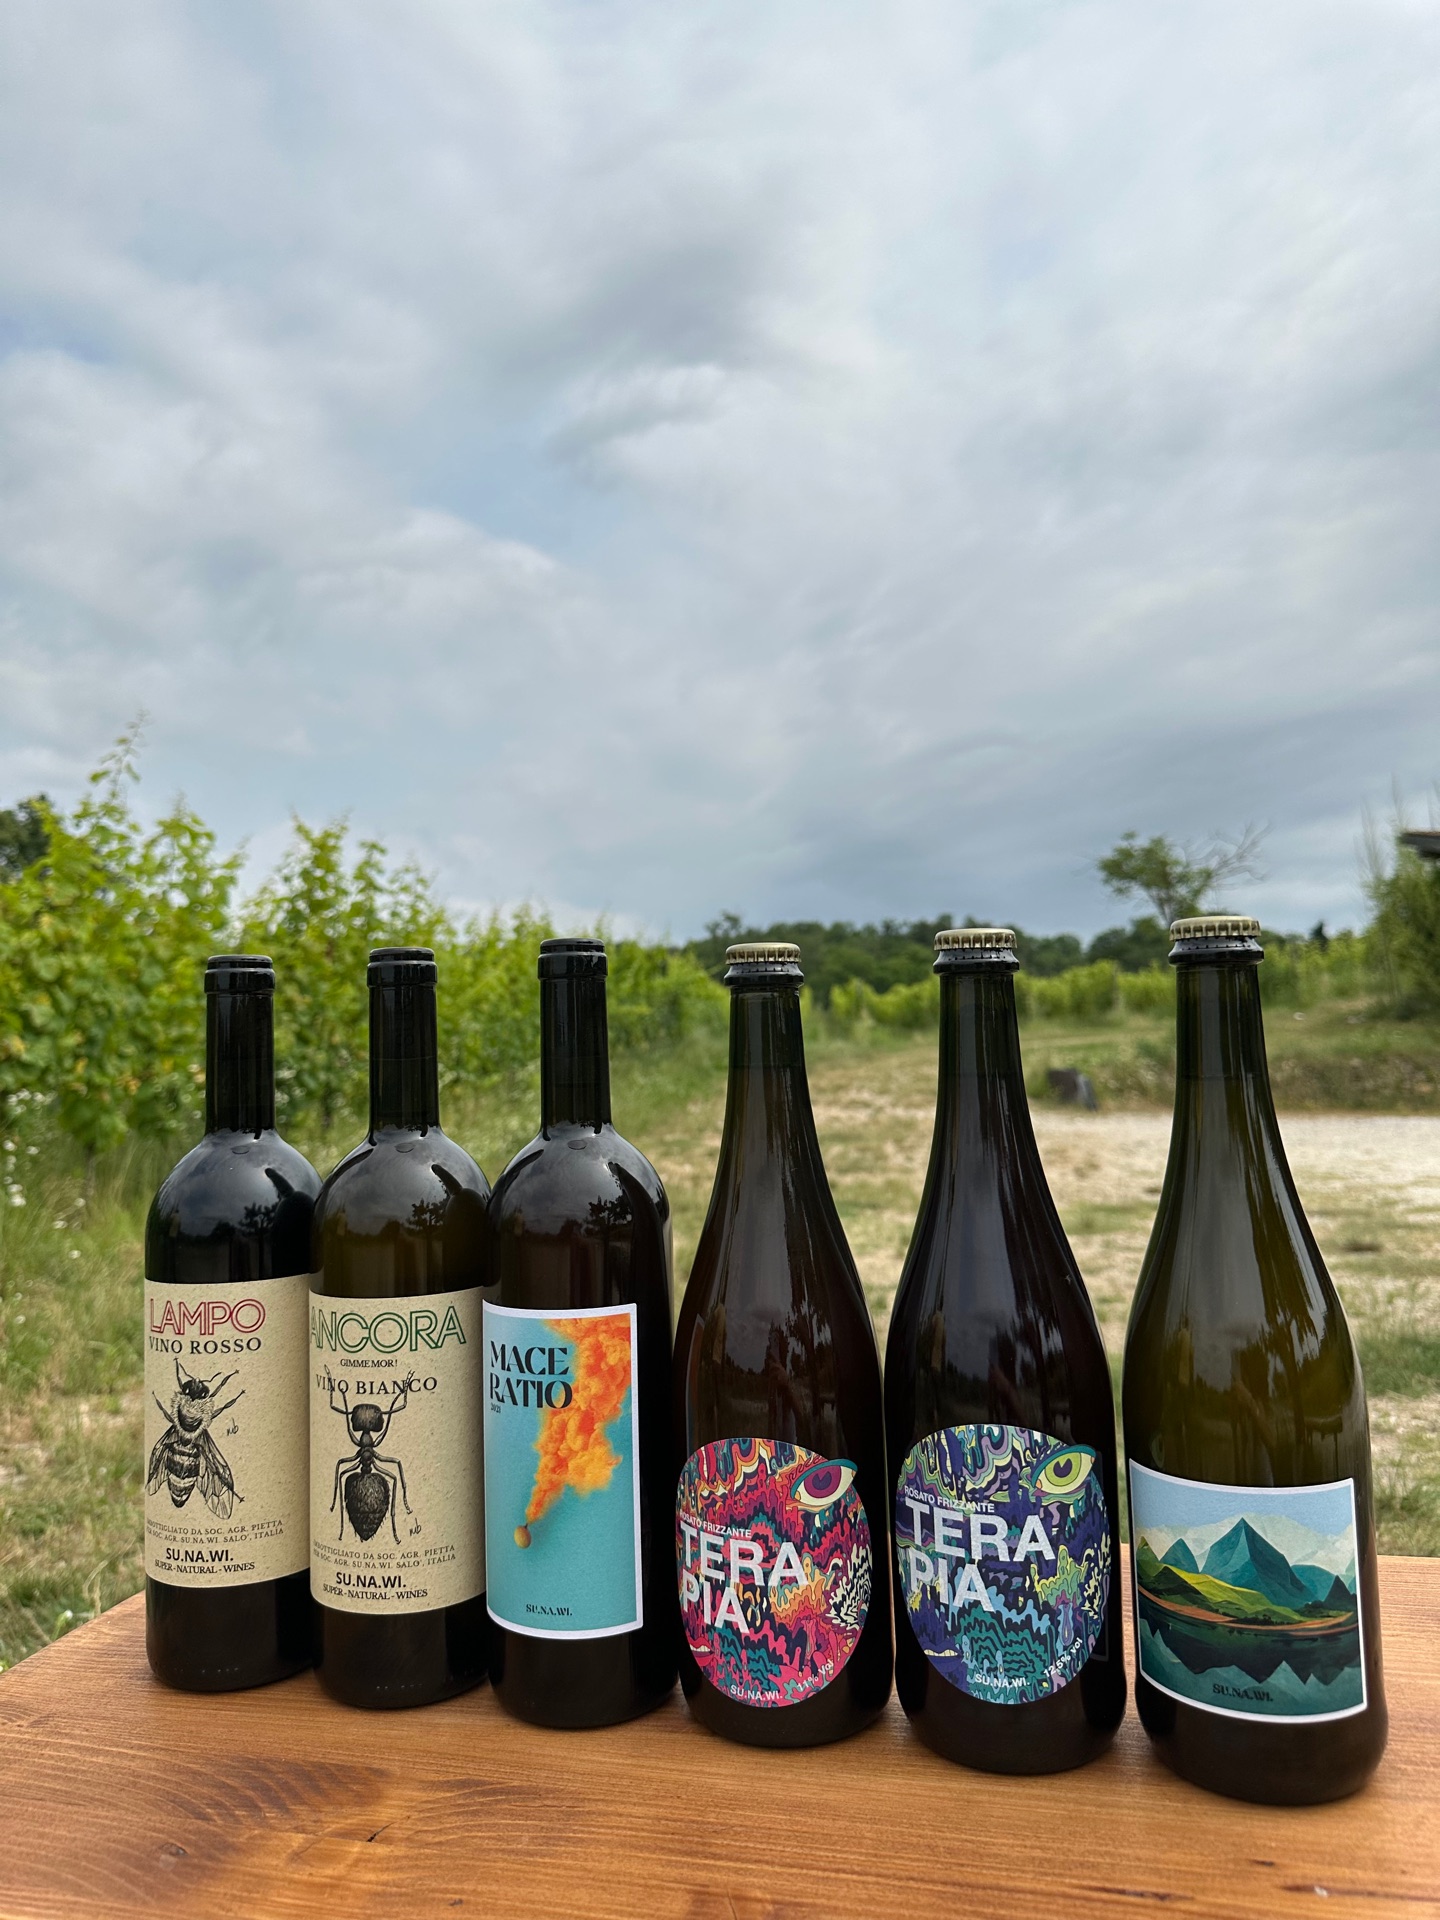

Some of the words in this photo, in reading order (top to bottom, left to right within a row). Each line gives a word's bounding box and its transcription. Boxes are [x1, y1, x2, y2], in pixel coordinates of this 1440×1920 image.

[150, 1298, 266, 1335] LAMPO
[310, 1306, 467, 1353] ANCORA
[149, 1335, 183, 1354] VINO
[190, 1337, 262, 1354] ROSSO
[340, 1358, 370, 1367] GIMME
[490, 1340, 569, 1375] MACE
[316, 1374, 349, 1393] VINO
[356, 1377, 437, 1395] BIANCO
[490, 1372, 573, 1409] RATIO
[904, 1485, 935, 1504] ROSATO
[937, 1496, 995, 1513] FRIZZANTE
[228, 1525, 249, 1533] AGR.
[251, 1519, 283, 1531] PIETTA
[255, 1528, 284, 1540] ITALIA
[703, 1520, 752, 1538] FRIZZANTE
[905, 1496, 1056, 1562] TERA
[166, 1547, 234, 1563] SU.NA.WI.
[363, 1552, 374, 1560] DA
[424, 1544, 455, 1557] PIETTA
[427, 1553, 456, 1565] ITALIA
[680, 1520, 809, 1586] TERA
[336, 1571, 406, 1588] SU.NA.WI.
[909, 1552, 995, 1613] PIA
[526, 1603, 573, 1616] SU.NA.WI.
[682, 1570, 749, 1633] PIA
[1070, 1637, 1083, 1654] vol
[797, 1674, 819, 1692] 11%
[975, 1673, 1030, 1688] SU.NA.WI.
[730, 1684, 783, 1700] SU.NA.WI.
